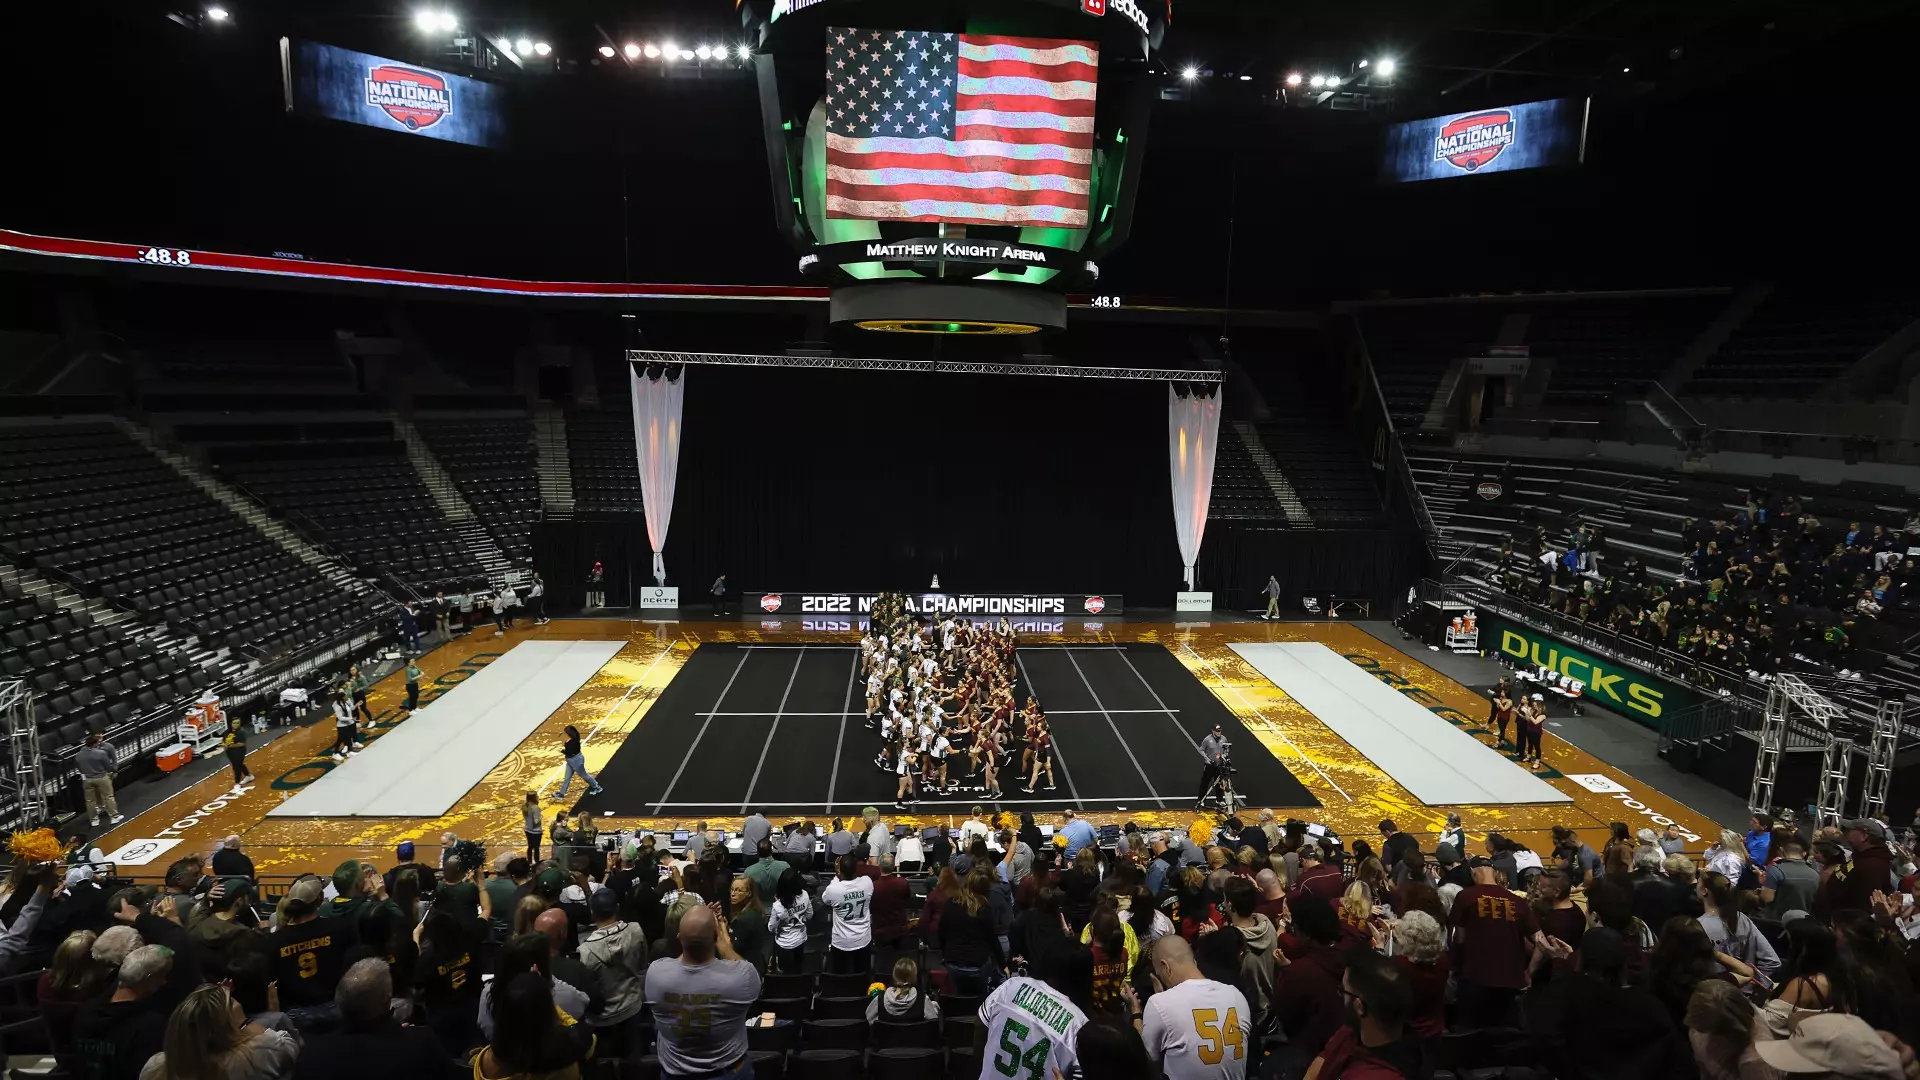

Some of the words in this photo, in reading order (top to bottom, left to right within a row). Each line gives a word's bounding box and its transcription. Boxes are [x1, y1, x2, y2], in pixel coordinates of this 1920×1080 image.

[369, 81, 447, 104] NATIONAL
[369, 96, 449, 112] CHAMPIONSHIPS
[1437, 136, 1511, 158] CHAMPIONSHIPS
[1438, 124, 1511, 150] NATIONAL
[139, 248, 190, 265] :48.8
[866, 243, 938, 257] MATTHEW
[942, 243, 999, 258] KNIGHT
[1001, 246, 1046, 262] ARENA
[1091, 295, 1121, 308] :48.8
[801, 596, 851, 612] 2022
[922, 597, 1065, 613] CHAMPIONSHIPS
[1502, 629, 1664, 719] DUCKS
[844, 890, 865, 901] HARRIS
[843, 900, 866, 921] 27
[280, 935, 331, 957] KITCHENS
[1092, 962, 1126, 976] ARROYO
[1192, 1007, 1245, 1065] 54
[994, 1016, 1053, 1080] 54
